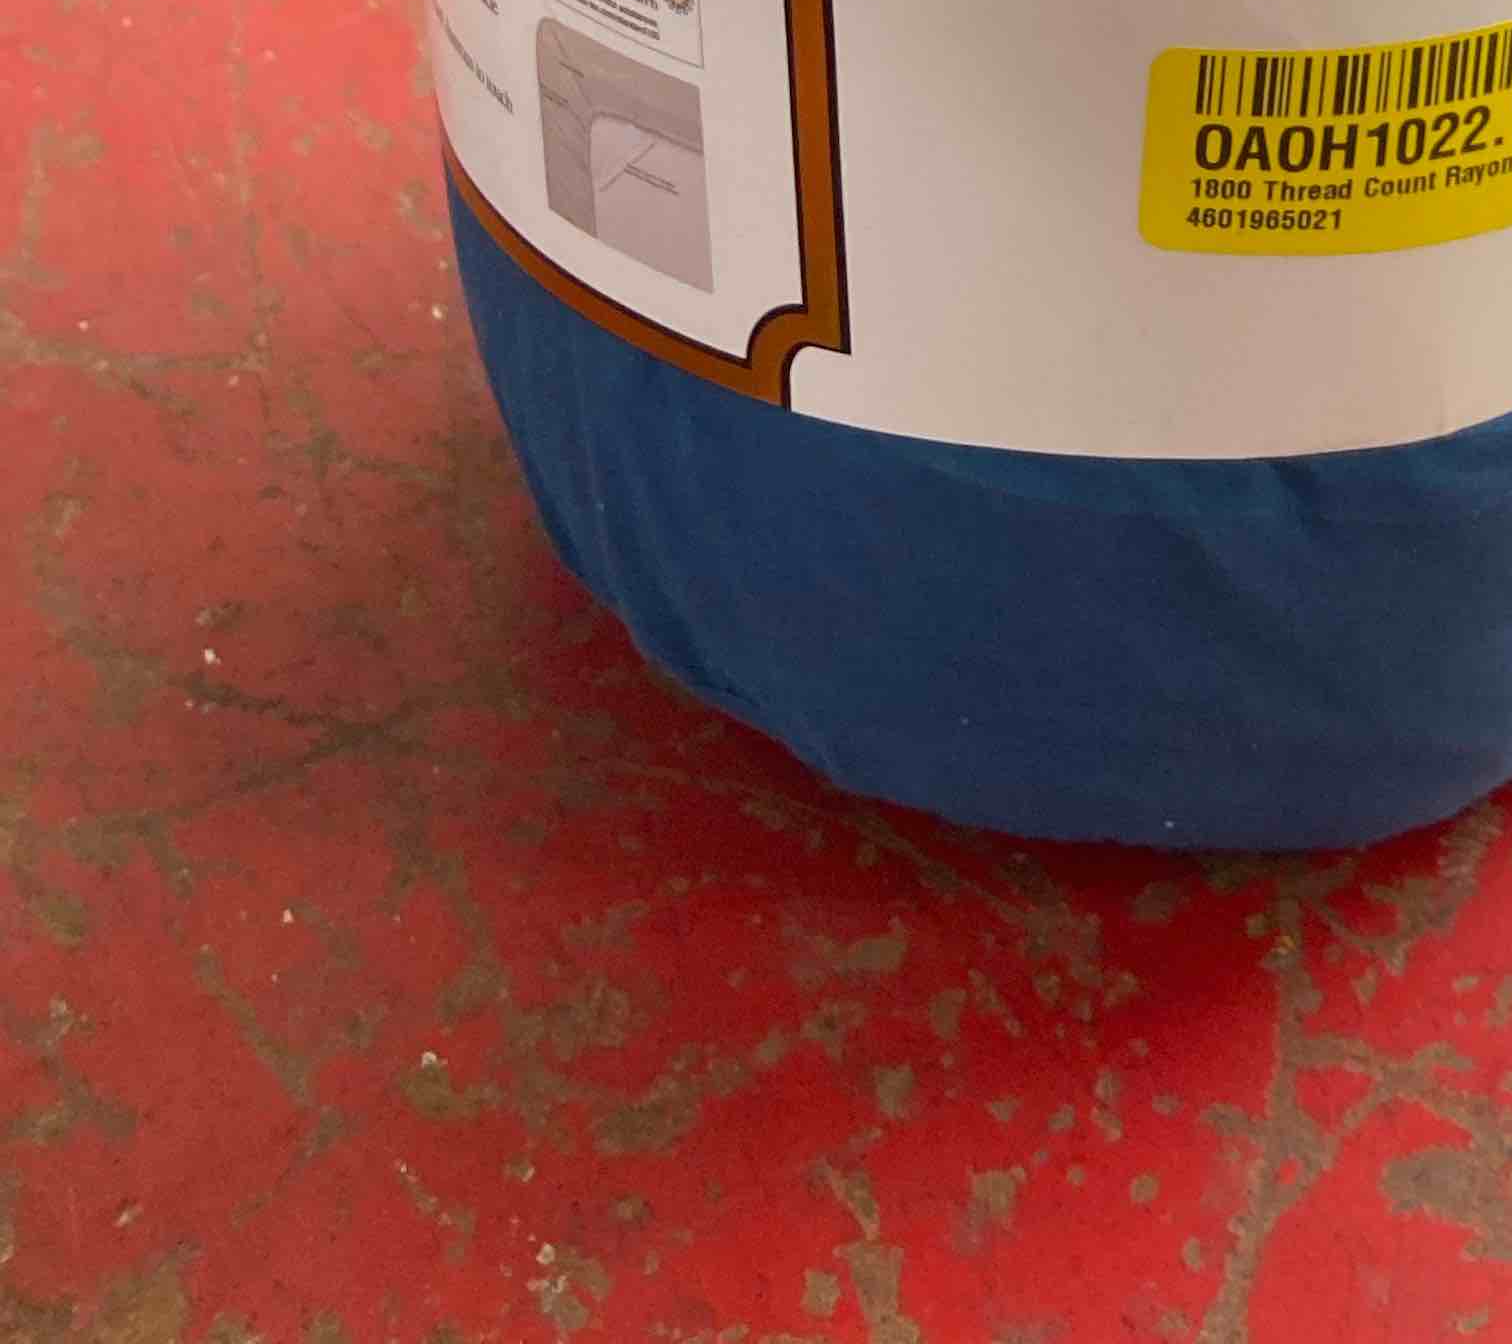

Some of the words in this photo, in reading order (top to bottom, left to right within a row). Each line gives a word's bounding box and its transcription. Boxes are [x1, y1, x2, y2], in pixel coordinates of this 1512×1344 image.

[1191, 178, 1252, 200] 1800
[1264, 179, 1353, 202] Thread
[1364, 171, 1437, 199] Count
[1185, 207, 1343, 231] 4601965021
